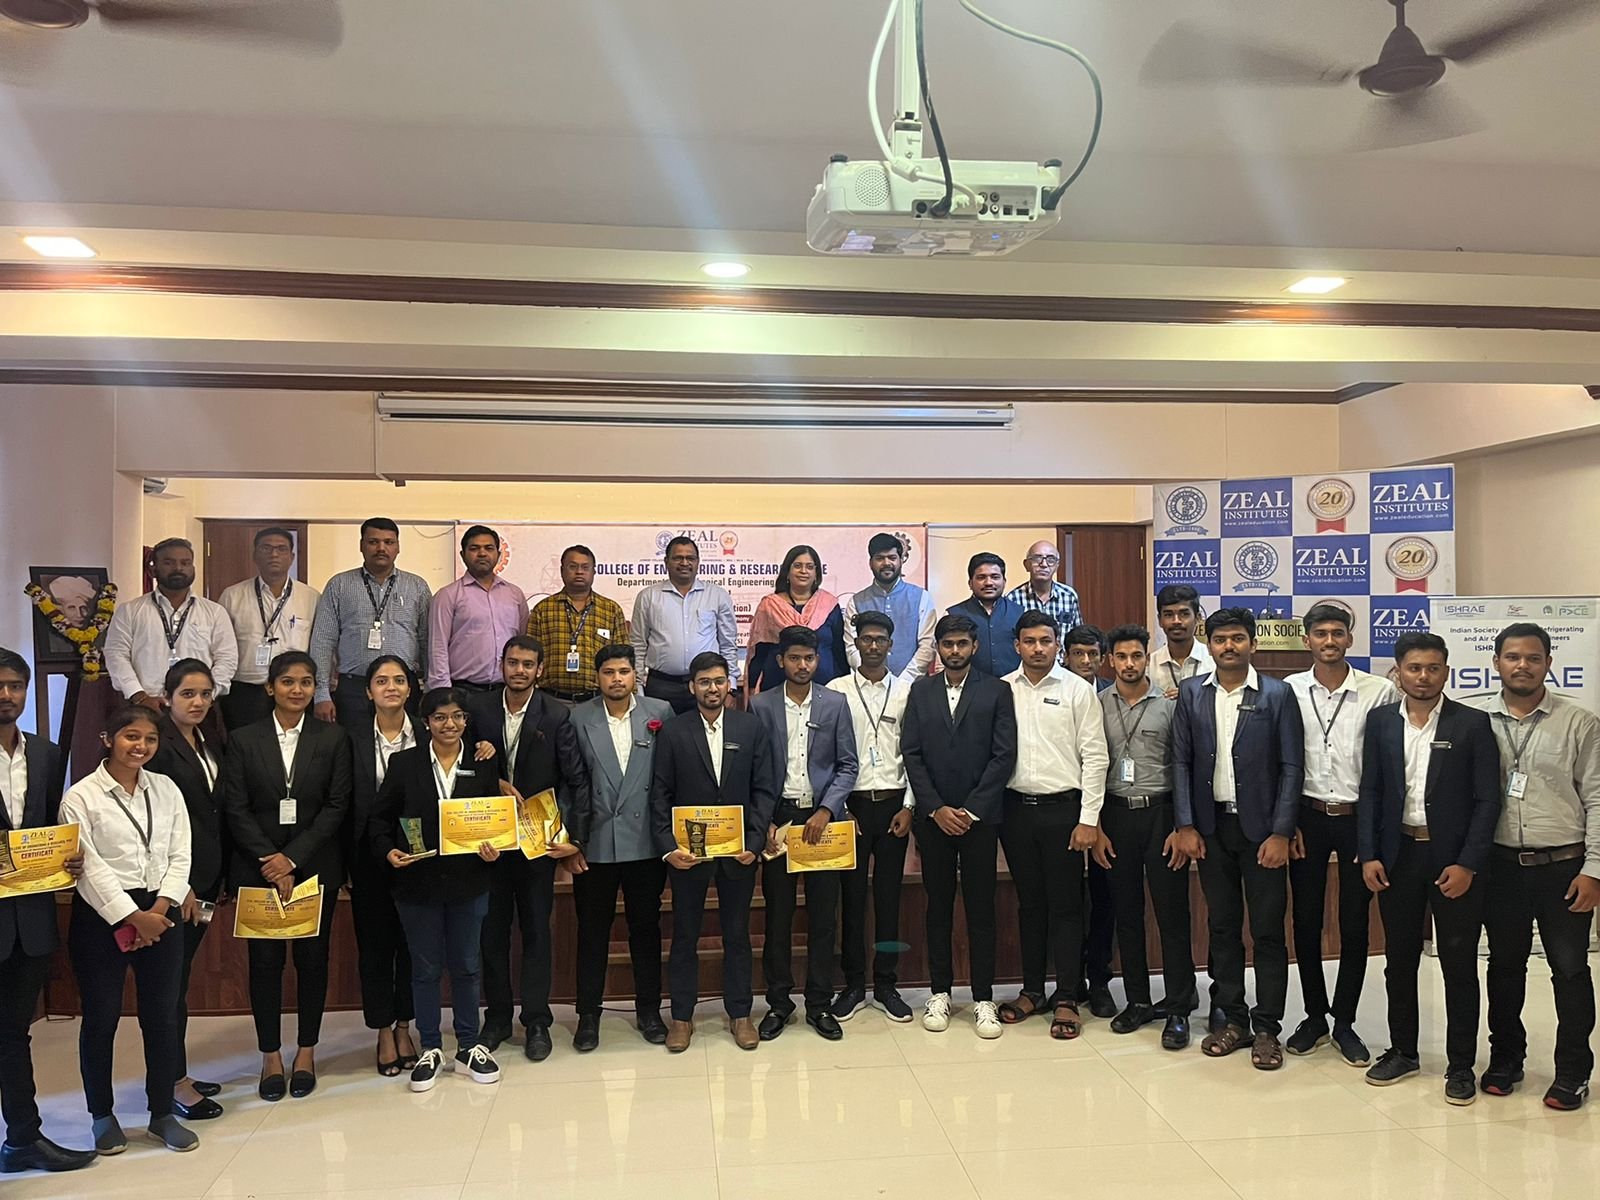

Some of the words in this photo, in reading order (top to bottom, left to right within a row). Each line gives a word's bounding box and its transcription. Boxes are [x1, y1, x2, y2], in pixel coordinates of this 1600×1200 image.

[1319, 491, 1343, 505] 20
[1373, 482, 1450, 503] ZEAL
[1223, 490, 1290, 510] ZEAL
[1225, 509, 1289, 519] INSTITUTES
[1375, 502, 1448, 514] INSTITUTES
[1156, 551, 1218, 568] ZEAL
[1296, 548, 1367, 566] ZEAL
[1399, 550, 1425, 564] 20
[595, 563, 633, 575] OLLEGE
[638, 563, 650, 575] OF
[729, 563, 736, 575] &
[740, 563, 779, 575] RESEAR
[1157, 569, 1217, 577] INSTITUTES
[1297, 567, 1365, 576] INSTITUTES
[728, 577, 775, 587] Engineering
[1444, 605, 1485, 613] ISHRAE
[1373, 609, 1430, 627] ZEA
[1274, 623, 1303, 637] SOCIE
[1543, 626, 1584, 634] efrigerating
